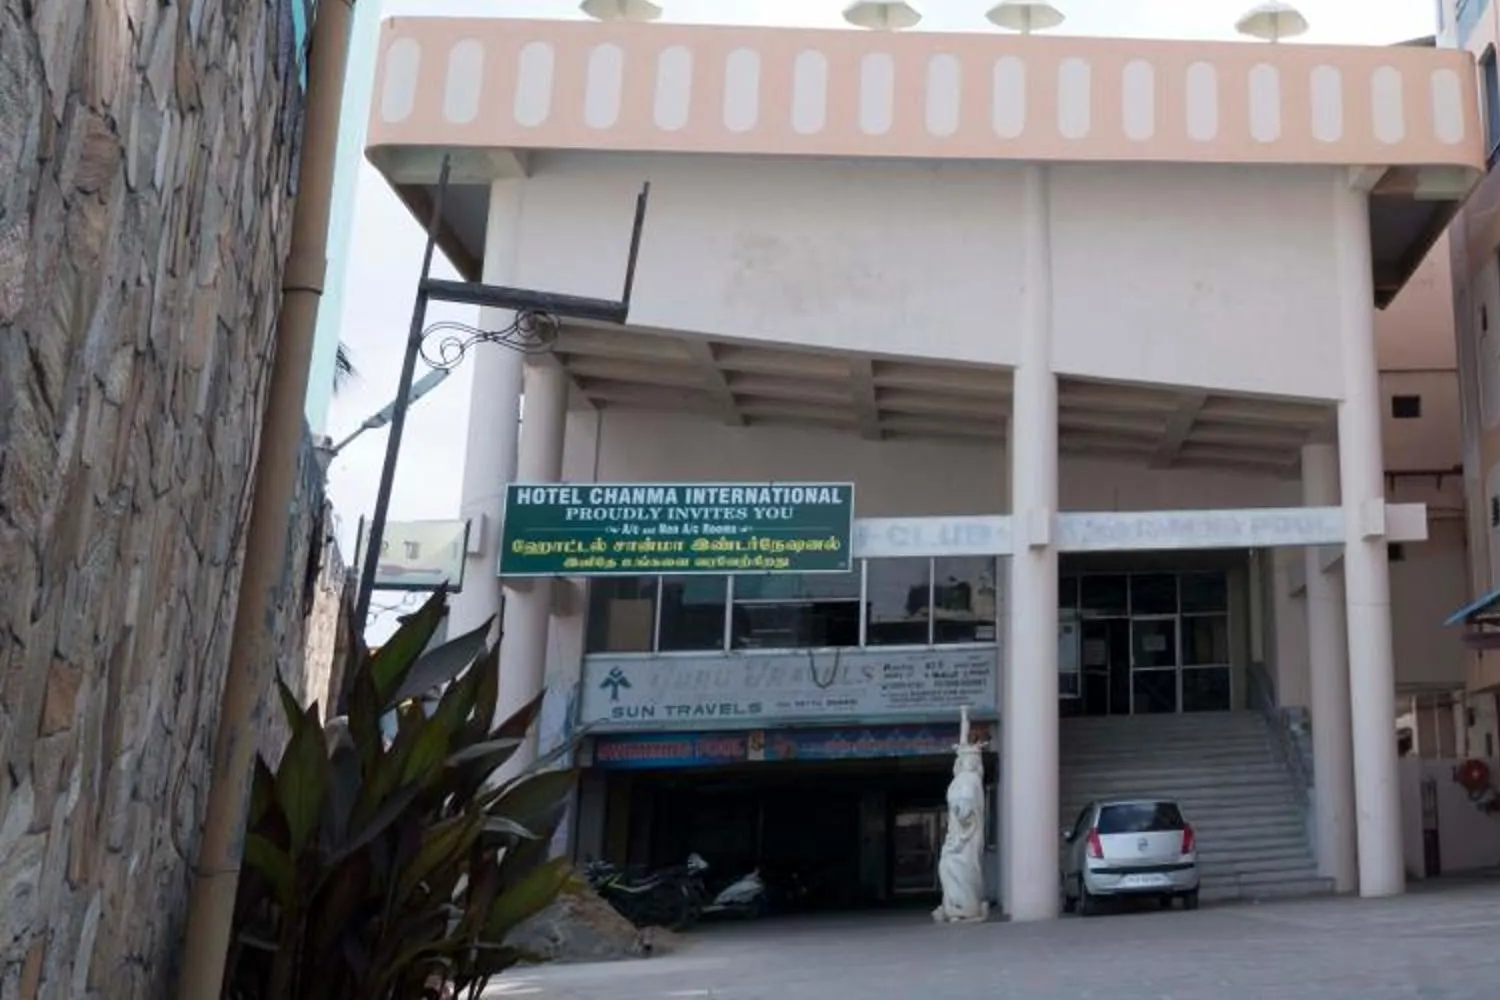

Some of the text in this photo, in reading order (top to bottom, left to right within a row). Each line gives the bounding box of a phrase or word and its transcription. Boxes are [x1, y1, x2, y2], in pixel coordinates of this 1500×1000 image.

[517, 487, 843, 505] HOTEL CHANMA INTERNATIONAL
[565, 507, 794, 521] PROUDLY INVITES YOU
[702, 523, 737, 534] Rooms
[611, 704, 656, 719] SUN
[664, 701, 763, 718] TRAVELS
